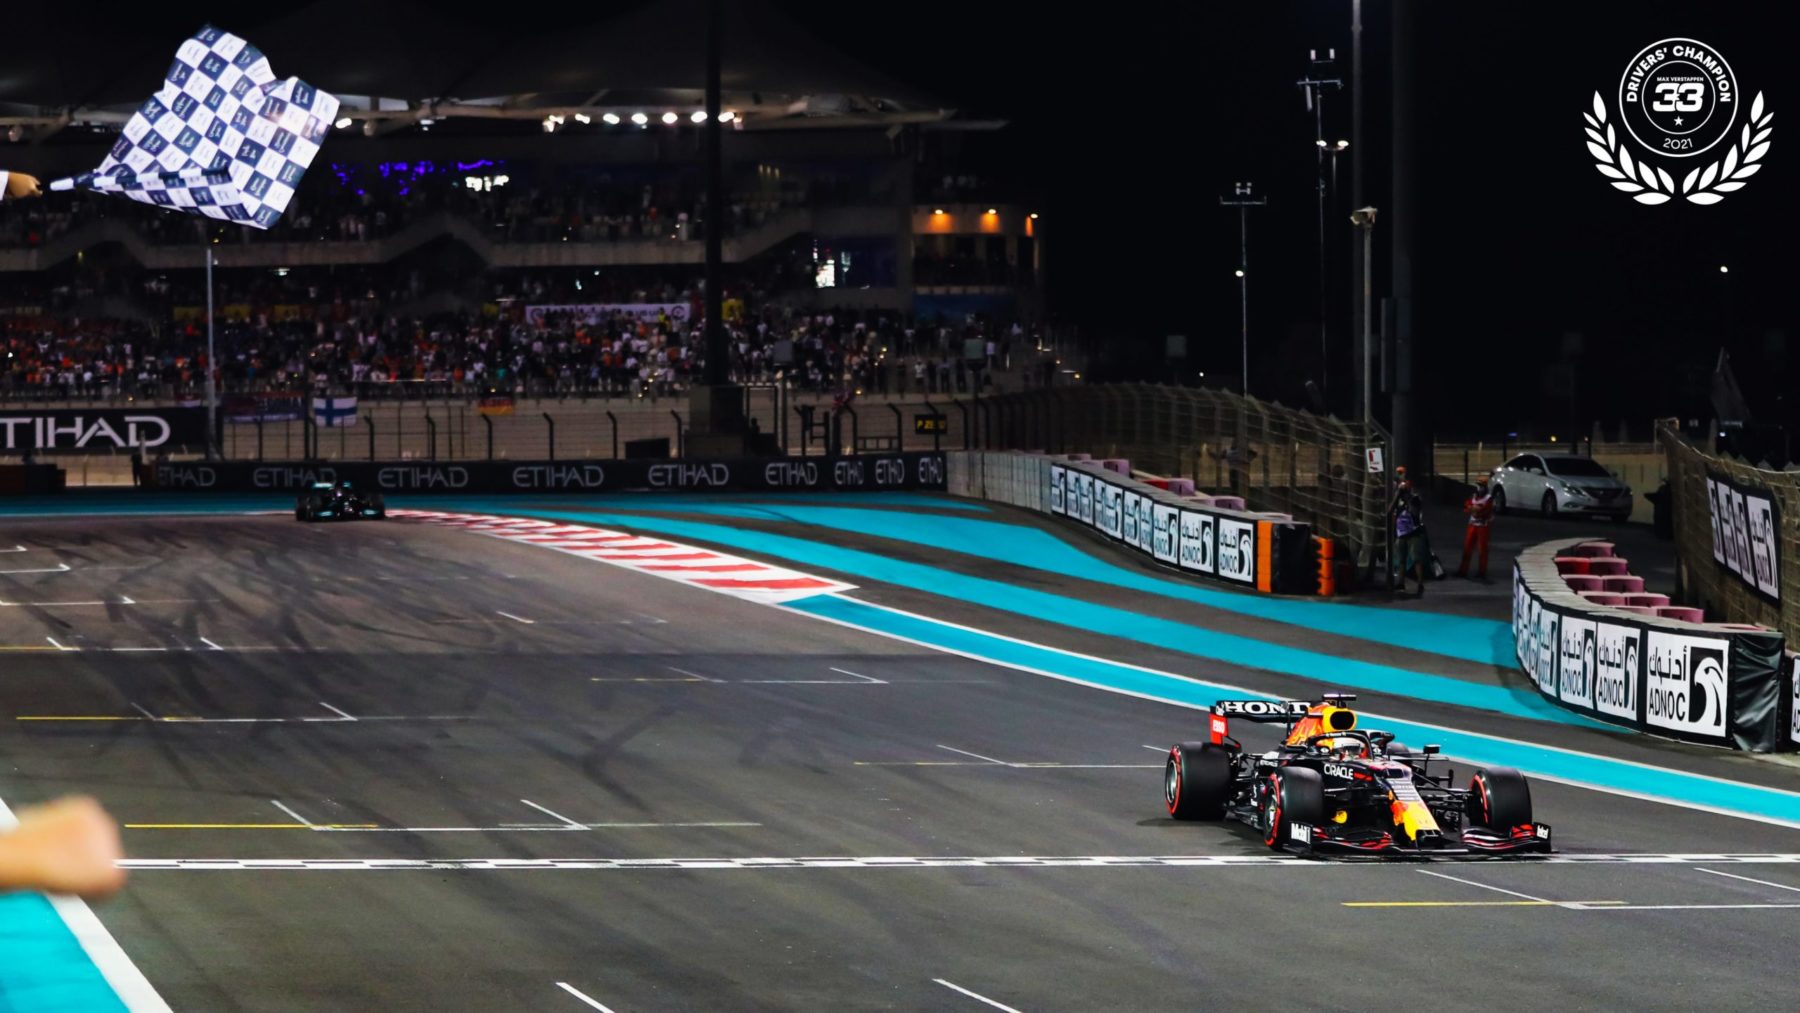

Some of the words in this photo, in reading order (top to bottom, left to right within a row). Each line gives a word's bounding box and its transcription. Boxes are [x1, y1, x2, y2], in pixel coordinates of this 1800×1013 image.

[0, 415, 171, 448] TIHAD
[252, 467, 338, 488] ETIHAD
[377, 467, 469, 489] ETIHAD
[512, 465, 605, 488] ETIHAD
[647, 463, 729, 486] ETIHAD
[765, 462, 818, 486] ETIHAD
[1561, 666, 1582, 698] ADNOC
[1597, 674, 1623, 708] ADNOC
[1224, 700, 1311, 715] HOND
[1649, 687, 1686, 722] ADNOC
[1323, 763, 1354, 781] ORACLE
